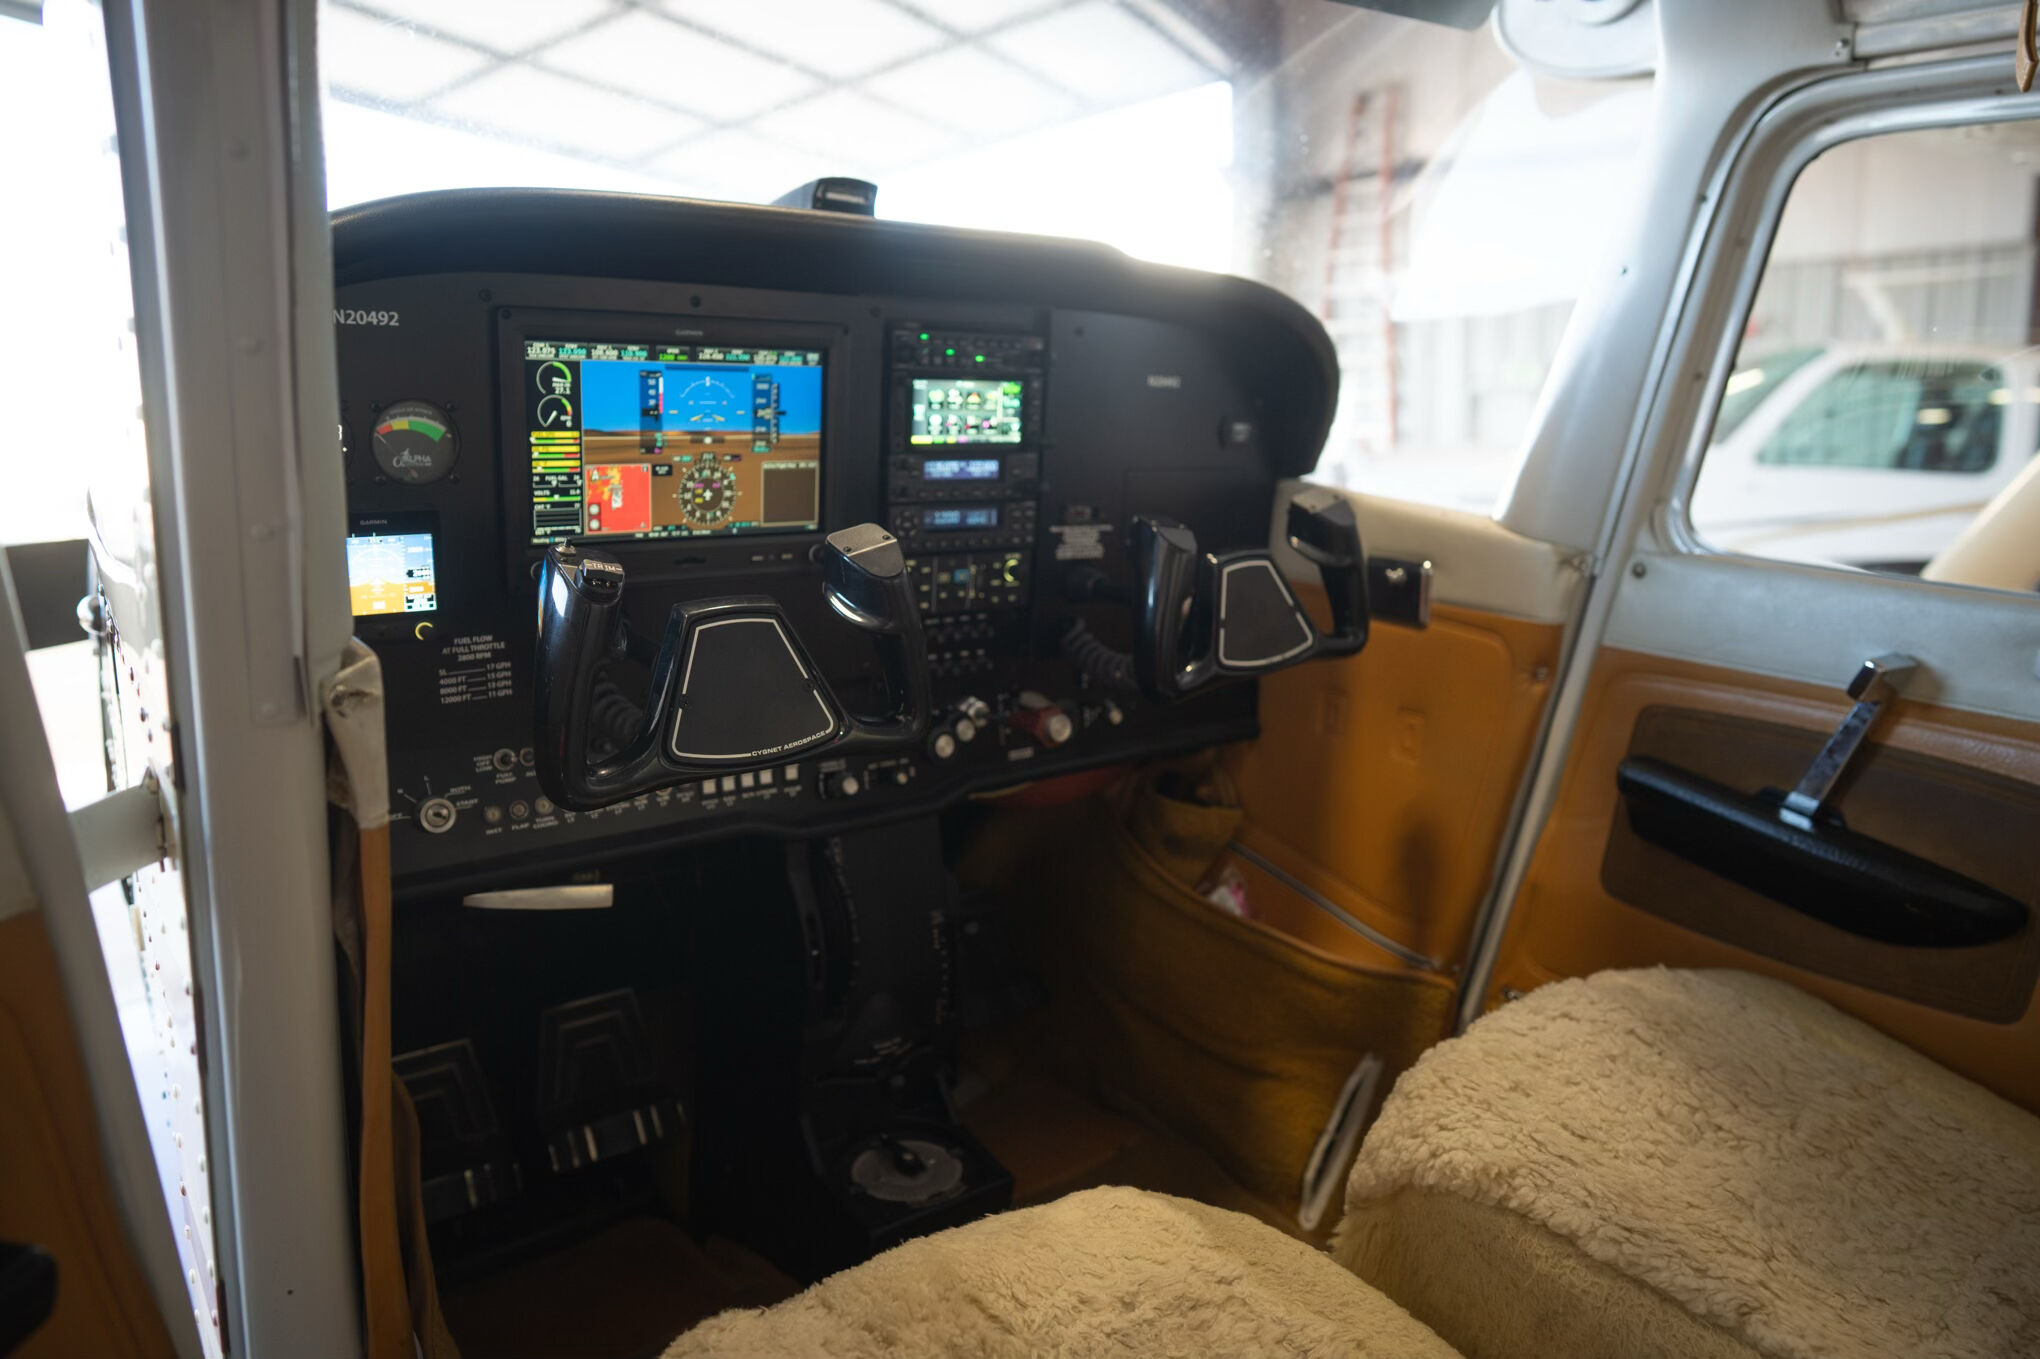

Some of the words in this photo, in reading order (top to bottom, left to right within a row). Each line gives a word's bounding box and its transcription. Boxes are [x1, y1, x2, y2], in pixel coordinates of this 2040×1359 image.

[333, 310, 399, 326] N20492
[593, 563, 616, 571] TRIM
[454, 637, 472, 645] FUEL
[473, 635, 493, 643] FLOW
[442, 647, 451, 655] AT
[452, 645, 470, 654] FULL
[470, 641, 505, 652] THROTTLE
[475, 652, 492, 660] RPM
[496, 661, 512, 669] GPH
[440, 677, 457, 685] 4000
[458, 685, 467, 693] FT
[496, 680, 512, 688] GPH
[441, 695, 461, 704] 12000
[462, 693, 472, 701] FT
[489, 690, 496, 698] 11
[497, 689, 512, 697] GPH
[752, 745, 782, 756] CYGNET
[784, 730, 826, 751] AEROSPACE
[456, 799, 479, 807] START
